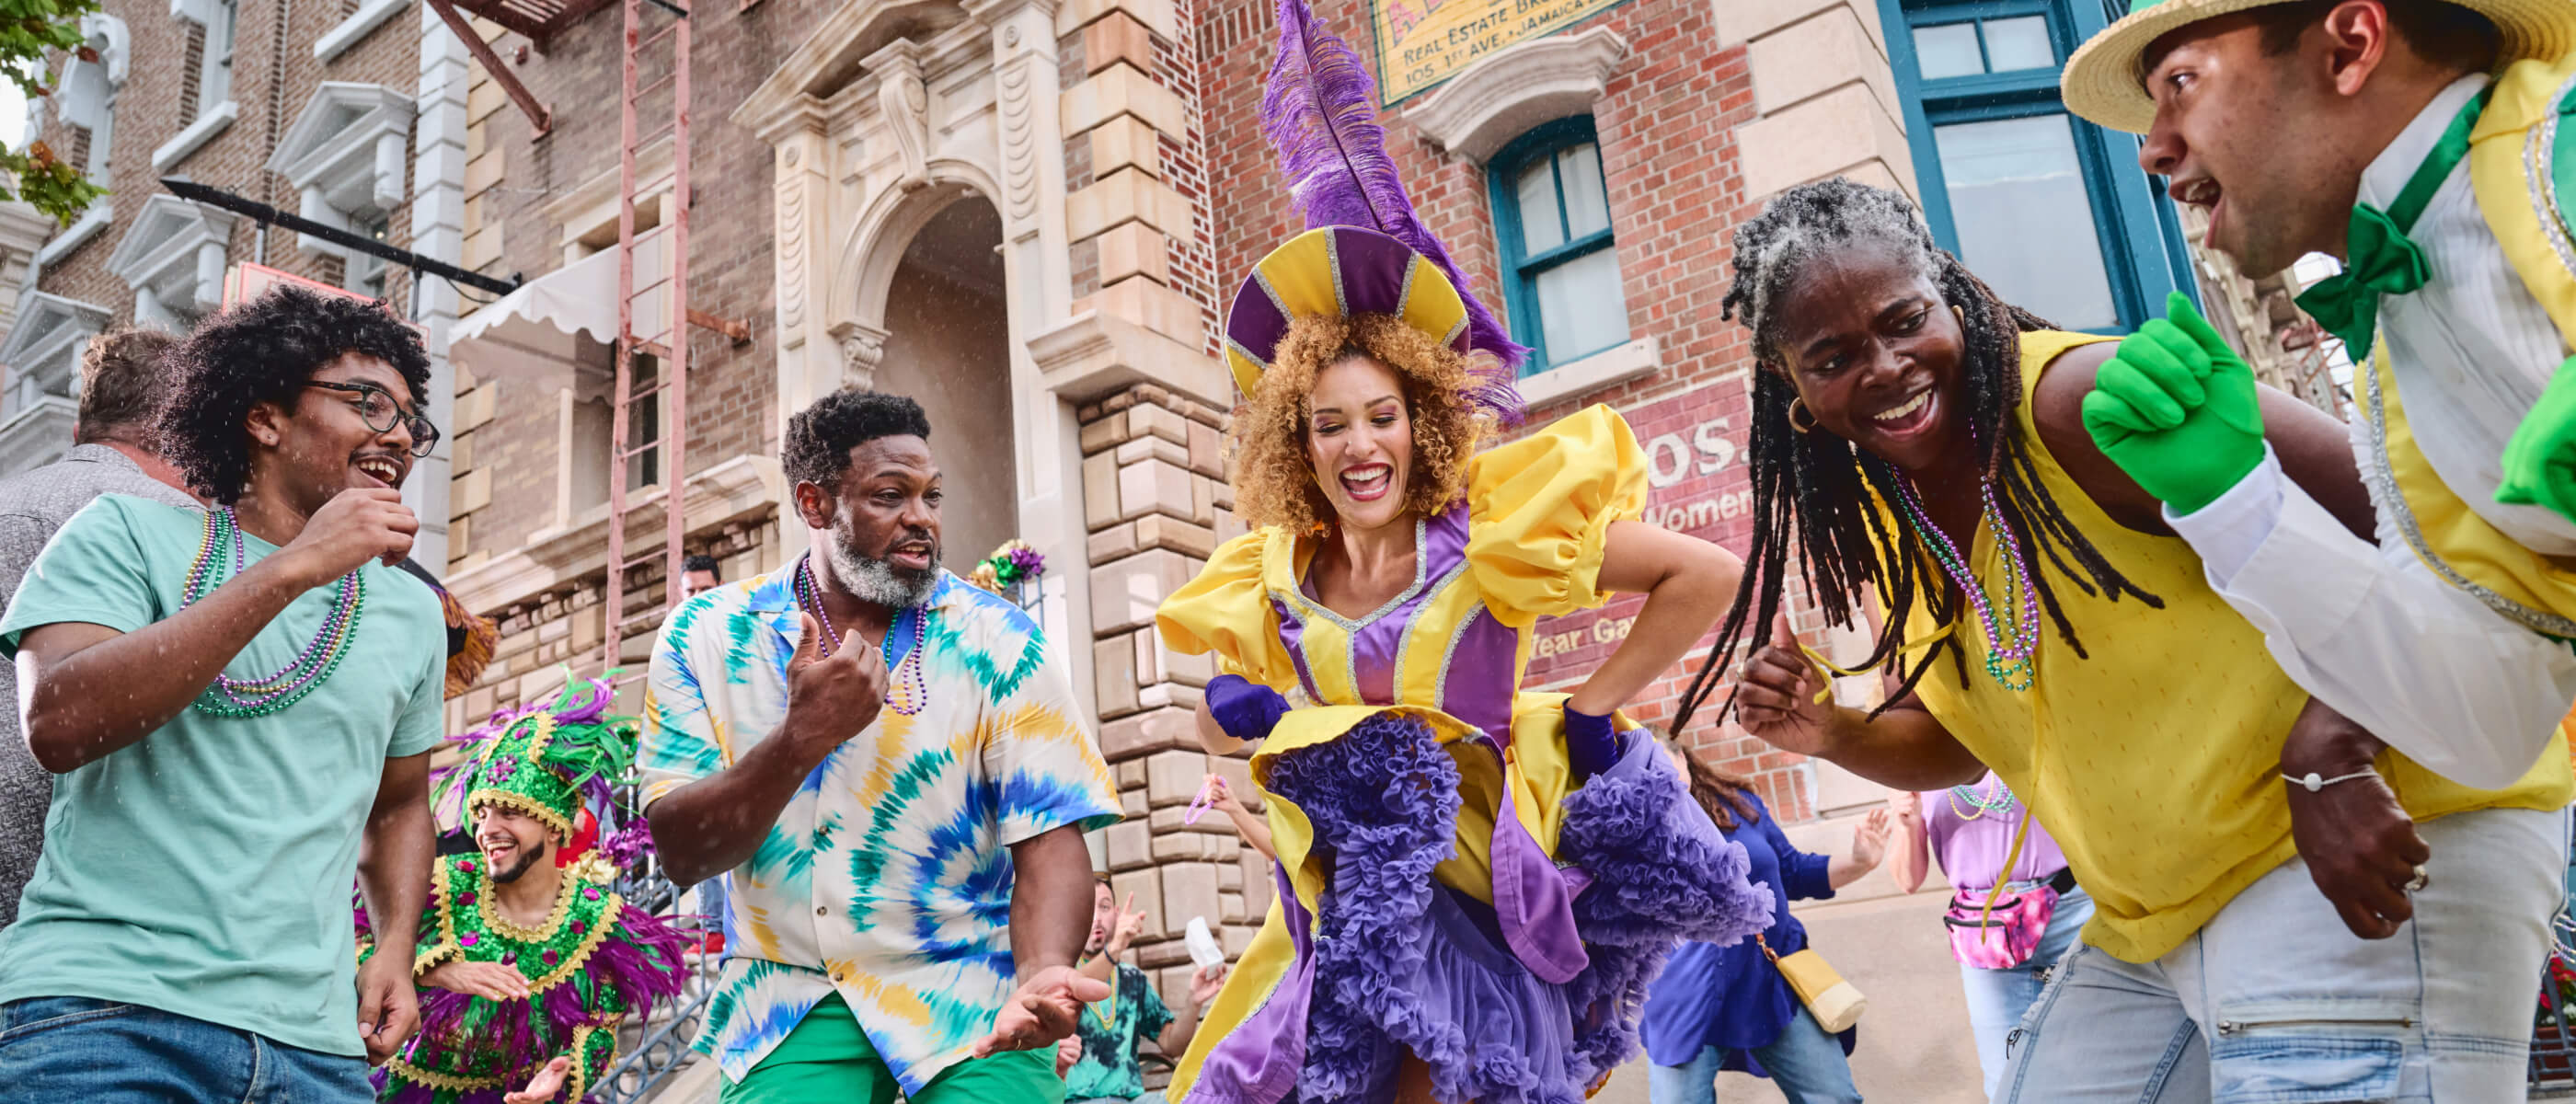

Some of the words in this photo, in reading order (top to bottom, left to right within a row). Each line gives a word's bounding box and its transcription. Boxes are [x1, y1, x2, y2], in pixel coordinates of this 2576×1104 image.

[1404, 40, 1443, 66] REAL
[1448, 8, 1508, 45] ESTATE
[1406, 63, 1434, 86] 105
[1469, 33, 1506, 58] AVE.
[1516, 0, 1583, 36] JAMAICA
[1593, 615, 1637, 643] Ga
